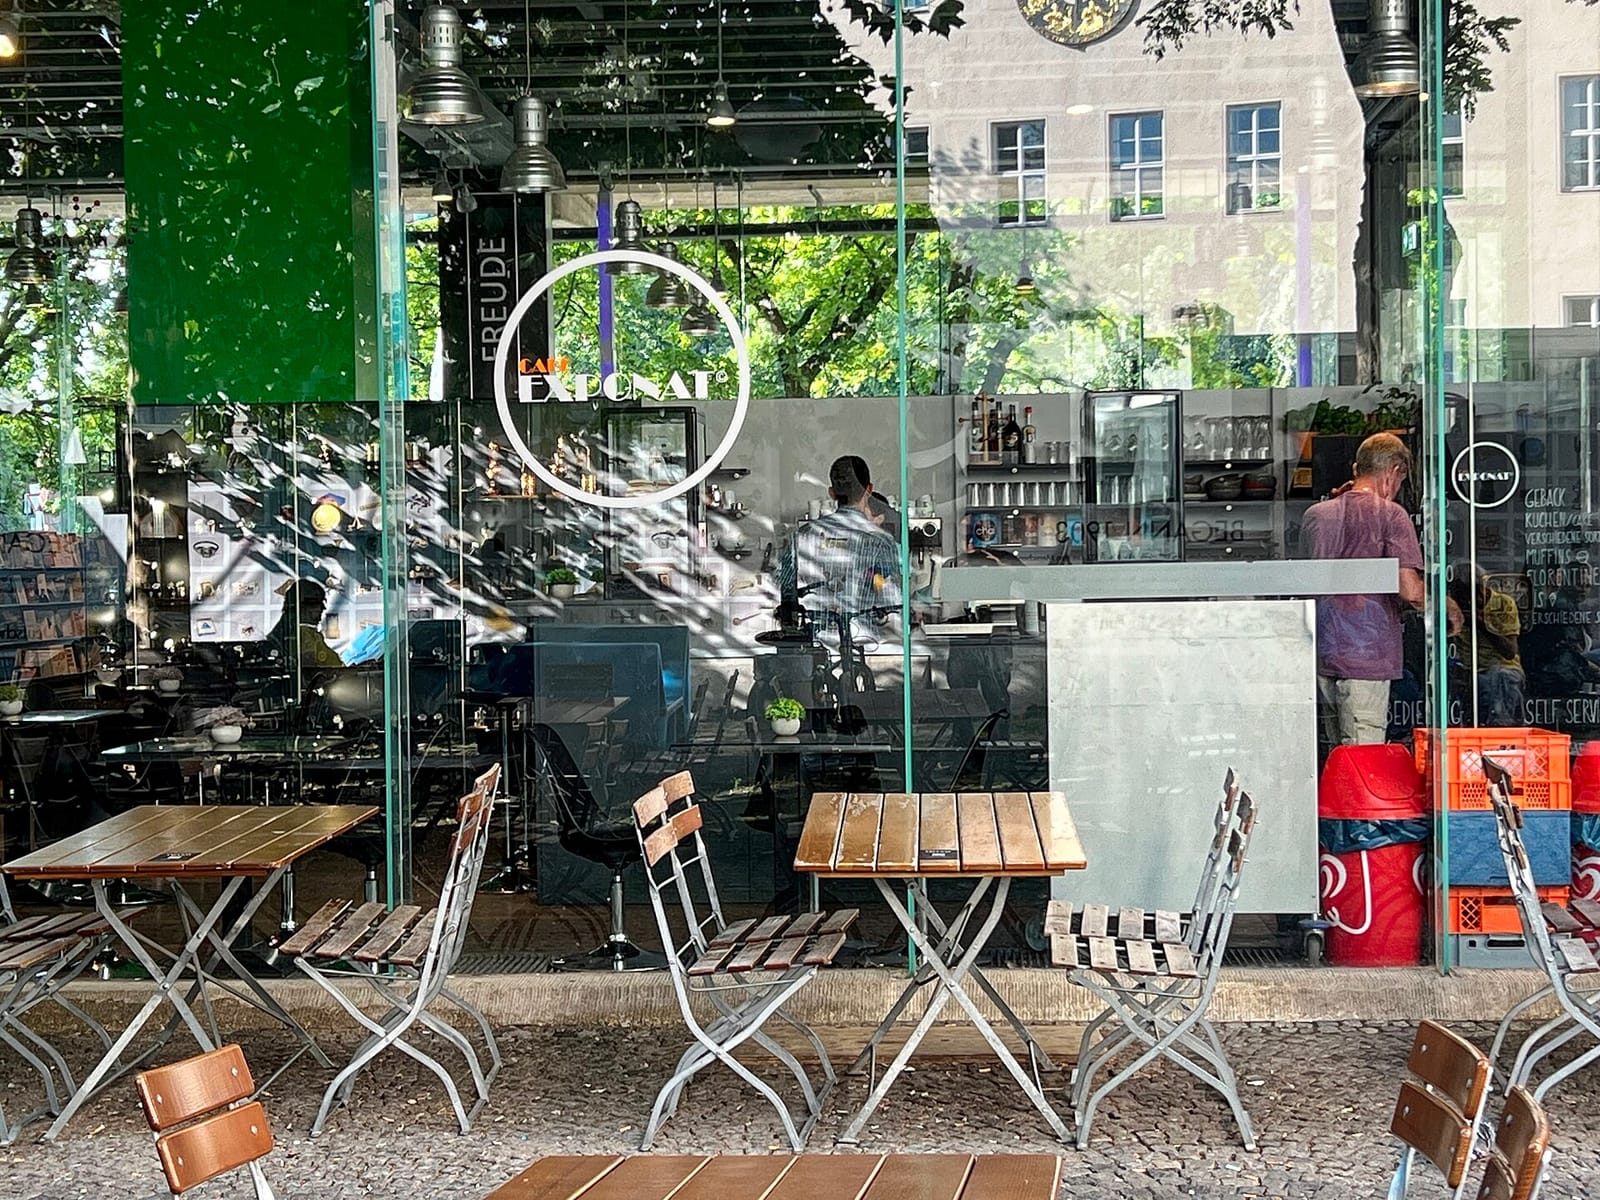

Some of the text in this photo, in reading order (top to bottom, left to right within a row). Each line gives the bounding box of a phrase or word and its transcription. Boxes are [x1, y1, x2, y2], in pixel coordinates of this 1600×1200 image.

[479, 238, 507, 361] FREUDE
[1526, 548, 1571, 565] MUFFINS
[1532, 611, 1591, 625] ERSCHIEDENE
[1524, 699, 1562, 725] SELF
